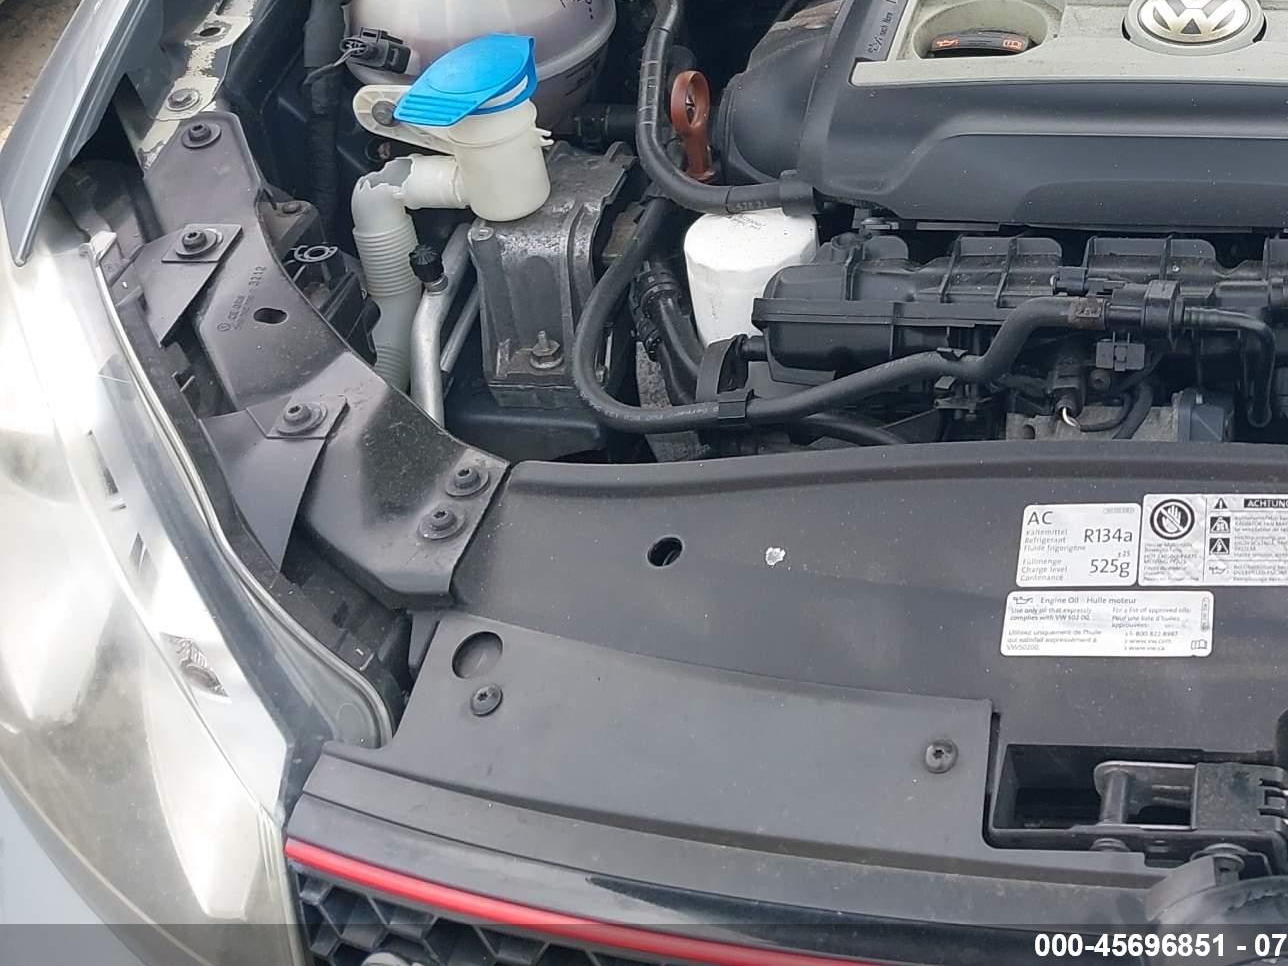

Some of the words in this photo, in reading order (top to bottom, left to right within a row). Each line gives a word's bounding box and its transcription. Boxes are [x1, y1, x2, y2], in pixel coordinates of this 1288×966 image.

[1027, 511, 1054, 526] AC
[1024, 536, 1066, 544] Refrigerant
[1084, 528, 1133, 543] R134a
[1020, 566, 1048, 574] Charge
[1089, 558, 1131, 578] 525g
[1040, 596, 1067, 606] Engine
[1068, 596, 1079, 604] Oil
[1086, 596, 1107, 604] Huile
[1010, 614, 1038, 622] complies
